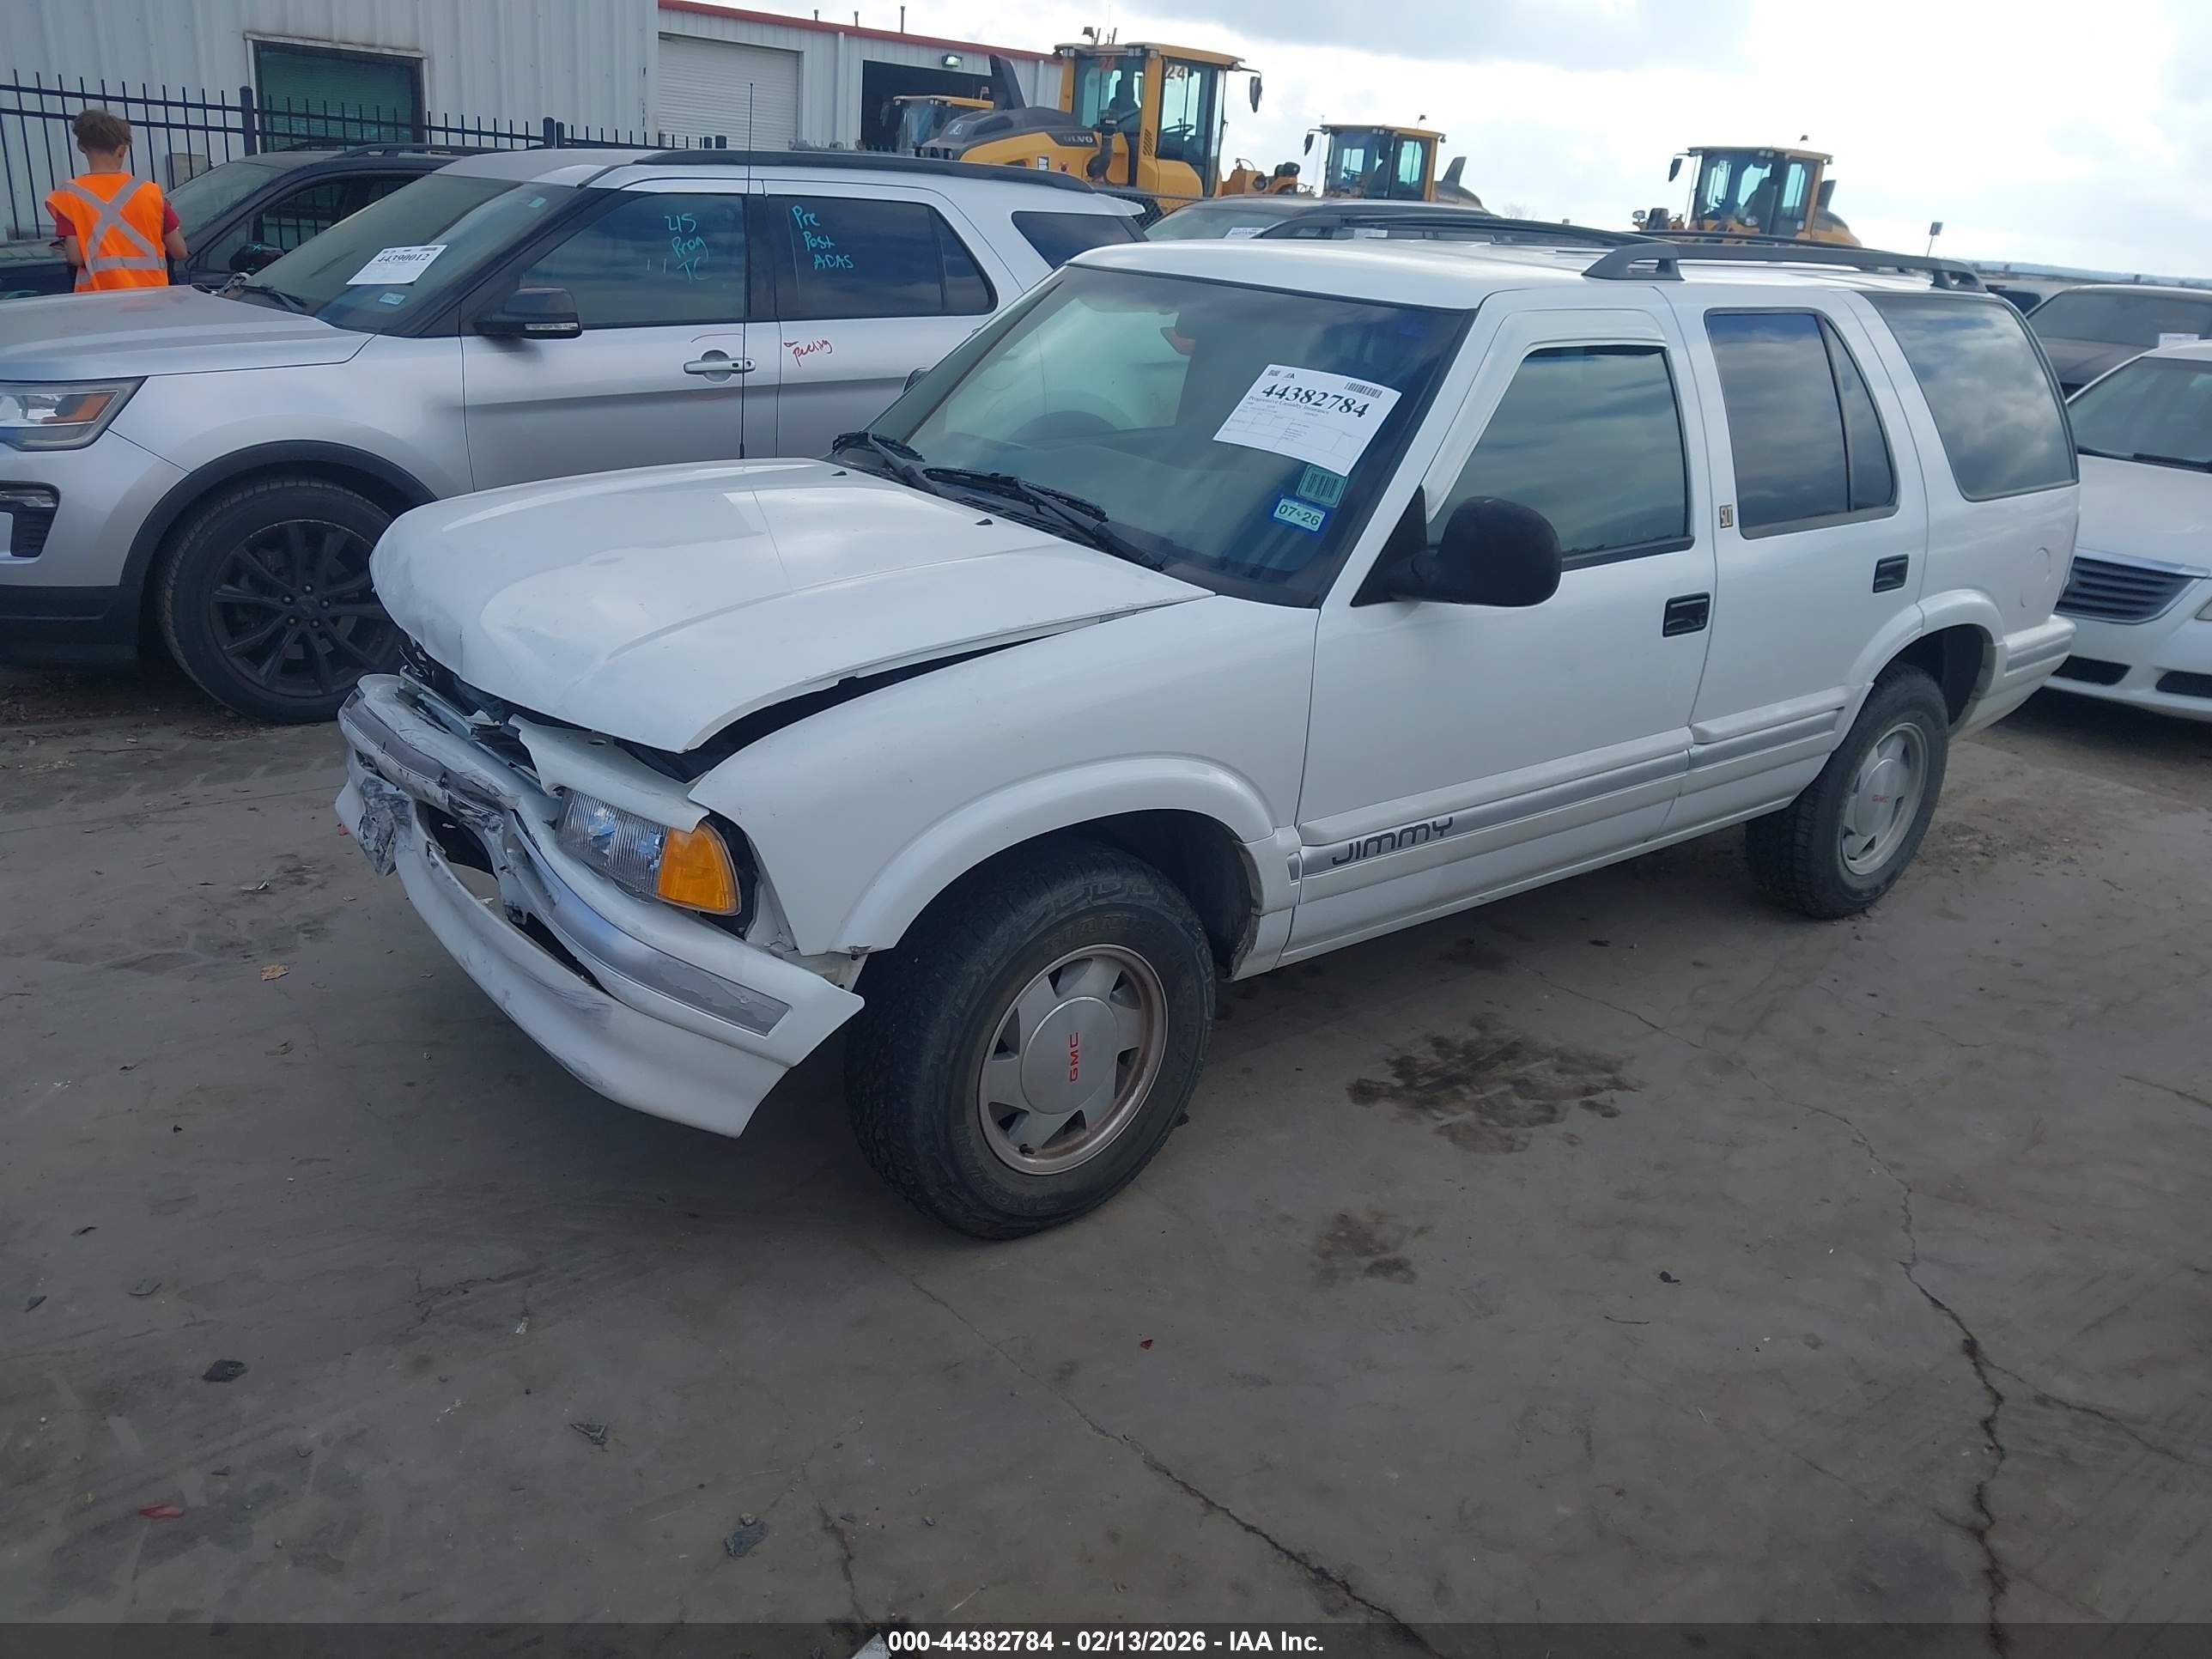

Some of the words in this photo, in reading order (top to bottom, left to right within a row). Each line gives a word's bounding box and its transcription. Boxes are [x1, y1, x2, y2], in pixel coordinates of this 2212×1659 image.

[1165, 64, 1186, 82] 24
[793, 205, 821, 229] Pre
[814, 254, 854, 270] ADAS
[1261, 383, 1370, 418] 44382784
[1279, 504, 1297, 517] 07
[1301, 512, 1321, 526] 26
[1070, 1032, 1079, 1082] GMC
